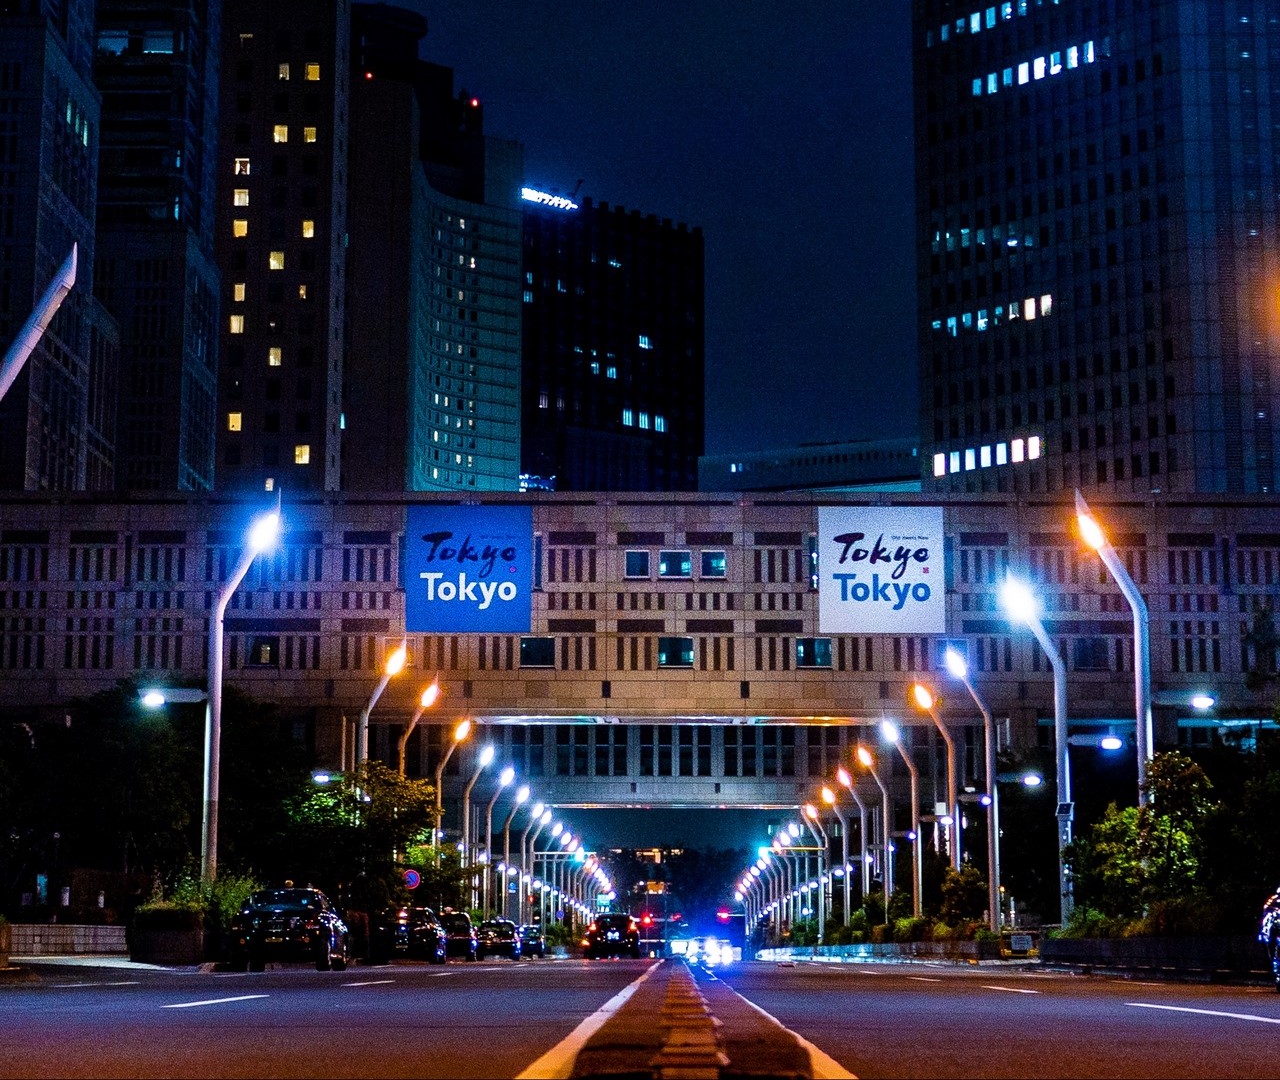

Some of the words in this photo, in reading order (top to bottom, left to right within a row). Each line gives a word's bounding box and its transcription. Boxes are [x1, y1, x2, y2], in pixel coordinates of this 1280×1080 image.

[422, 531, 517, 578] Tokyo
[833, 532, 929, 580] Tokyo
[419, 572, 517, 610] Tokyo
[832, 573, 931, 610] Tokyo
